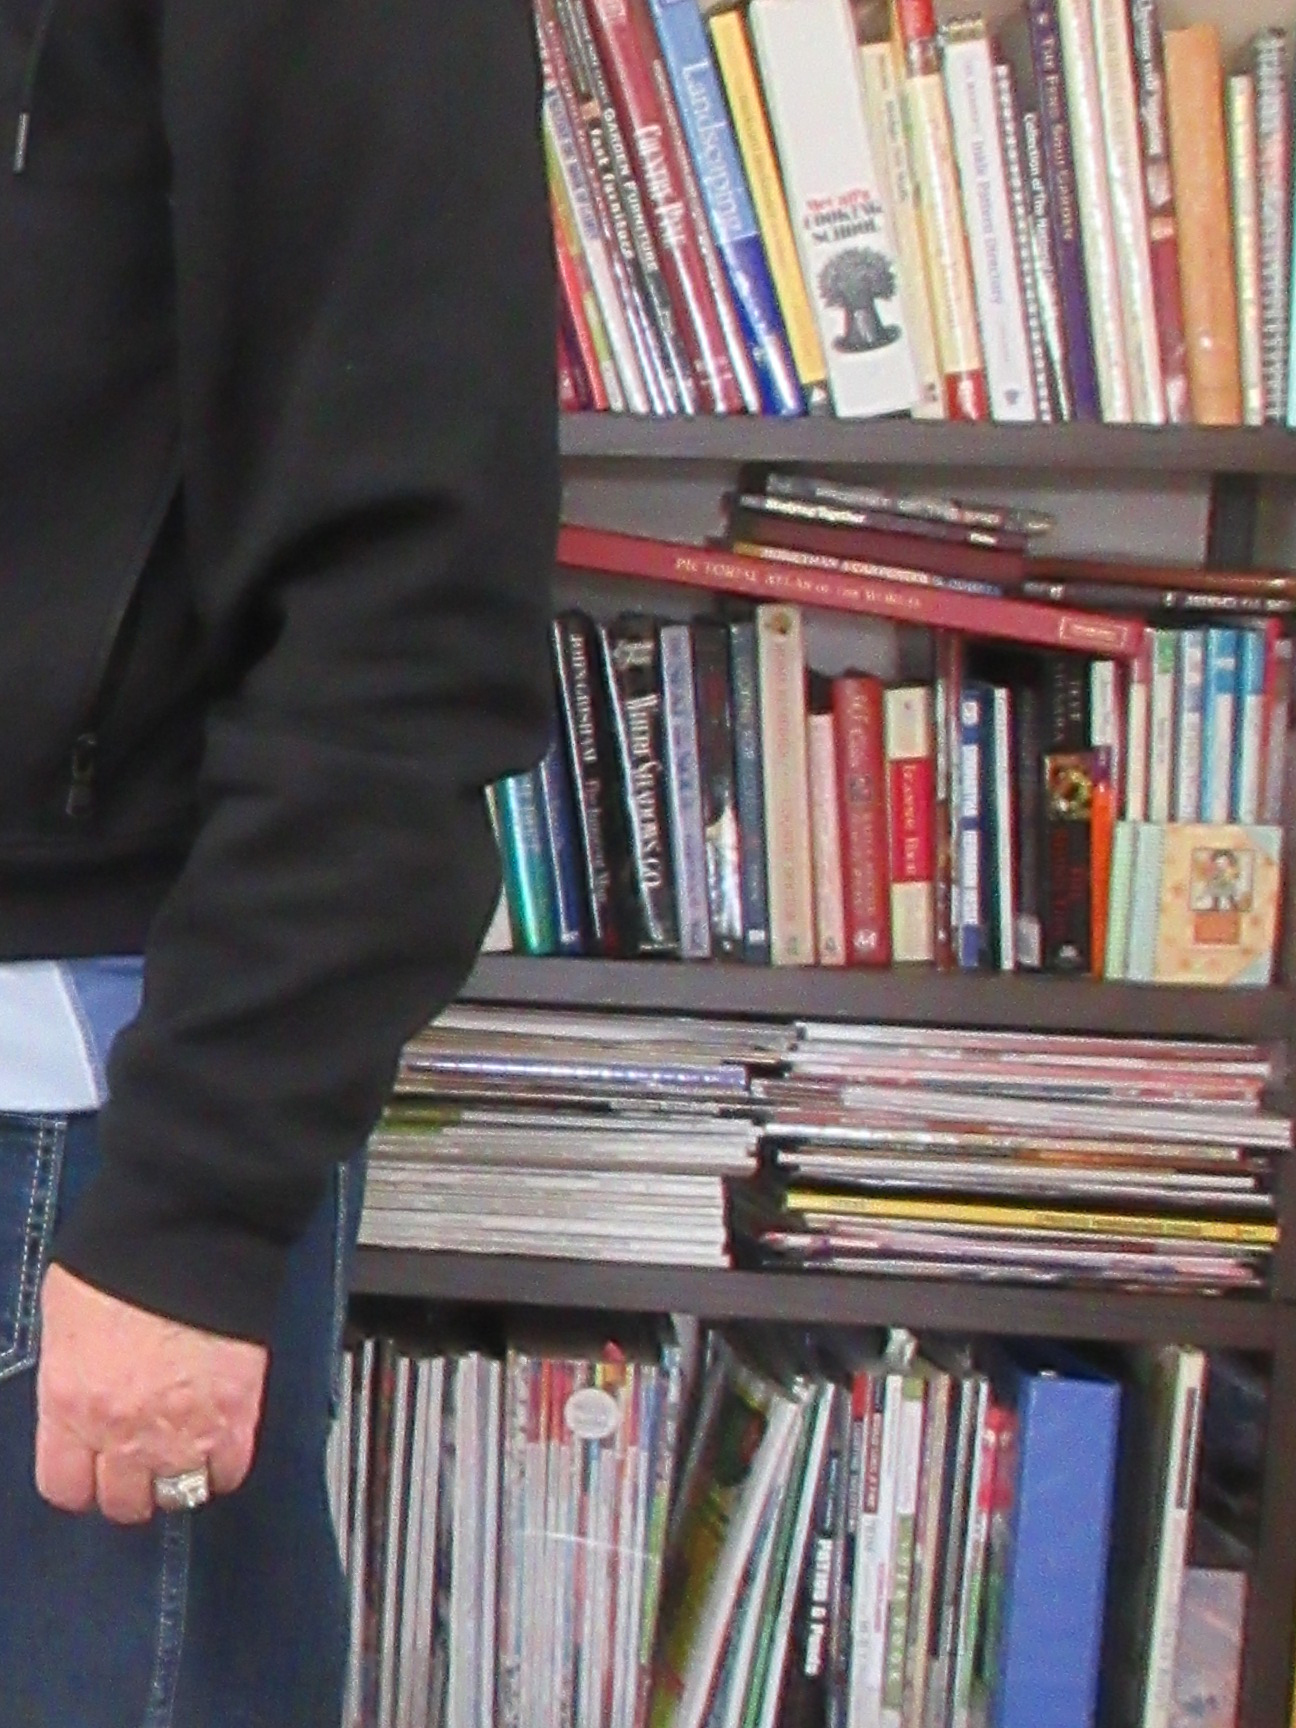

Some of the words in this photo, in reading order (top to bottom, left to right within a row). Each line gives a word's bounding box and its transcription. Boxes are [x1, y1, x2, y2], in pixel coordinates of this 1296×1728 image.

[682, 64, 743, 236] Landscaping
[1022, 112, 1042, 175] Collection
[589, 127, 609, 169] fast
[601, 172, 636, 259] furniture
[602, 106, 633, 174] GARDEN
[622, 178, 660, 272] FURNITURE
[975, 180, 996, 233] Pattern
[983, 237, 1006, 305] Directory
[567, 631, 588, 680] JOHN
[574, 682, 599, 764] GRISHAM
[625, 694, 654, 757] WHERE
[632, 760, 660, 852] SHADOWS
